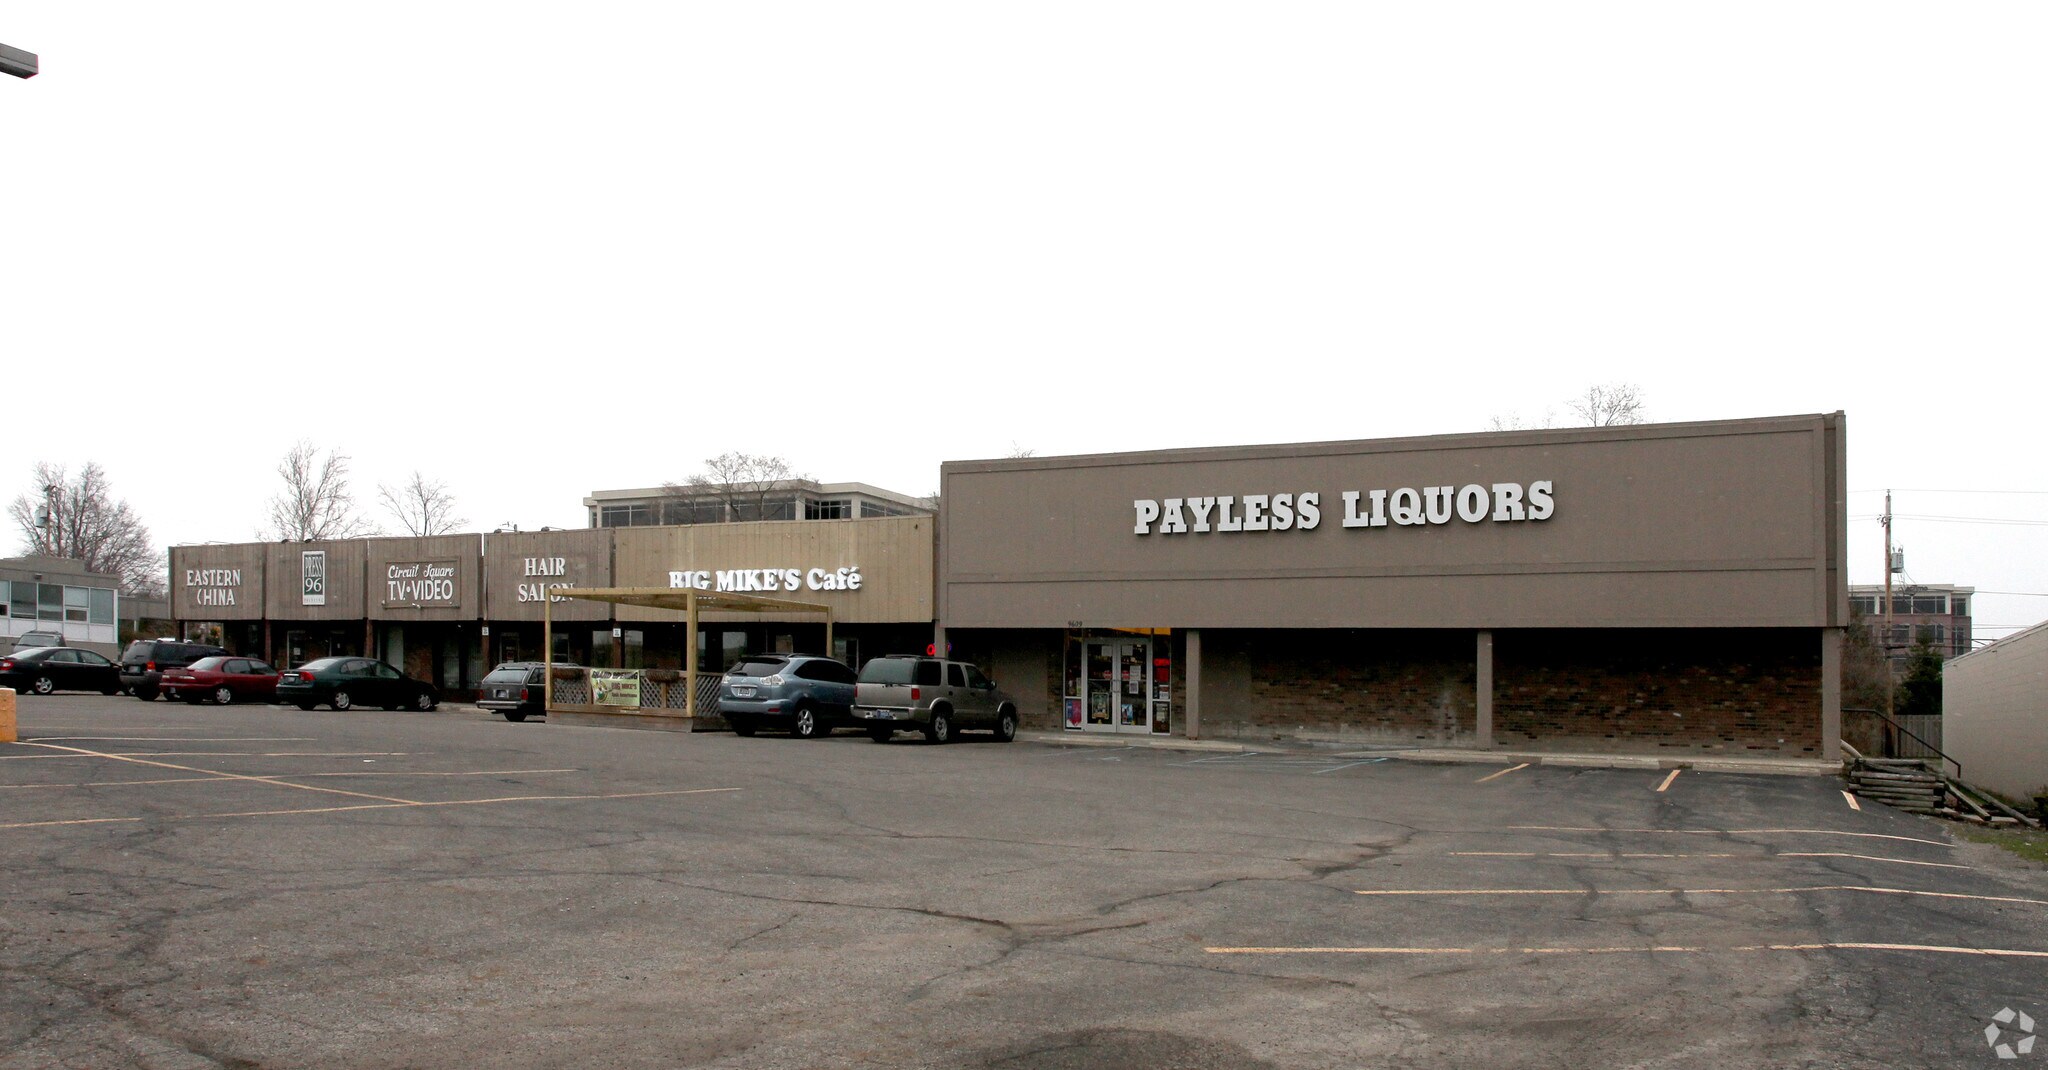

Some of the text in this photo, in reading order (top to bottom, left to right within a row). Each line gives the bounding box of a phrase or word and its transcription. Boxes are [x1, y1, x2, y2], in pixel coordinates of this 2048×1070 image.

[1133, 480, 1556, 535] PAYLESS LIQUORS
[304, 556, 323, 577] PRESS
[388, 563, 455, 581] Circuit Square
[524, 557, 566, 576] HAIR
[186, 569, 241, 586] EASTERN
[305, 577, 322, 592] 96
[715, 568, 802, 592] MIKE'S
[806, 566, 863, 591] Café
[196, 588, 236, 606] CHINA
